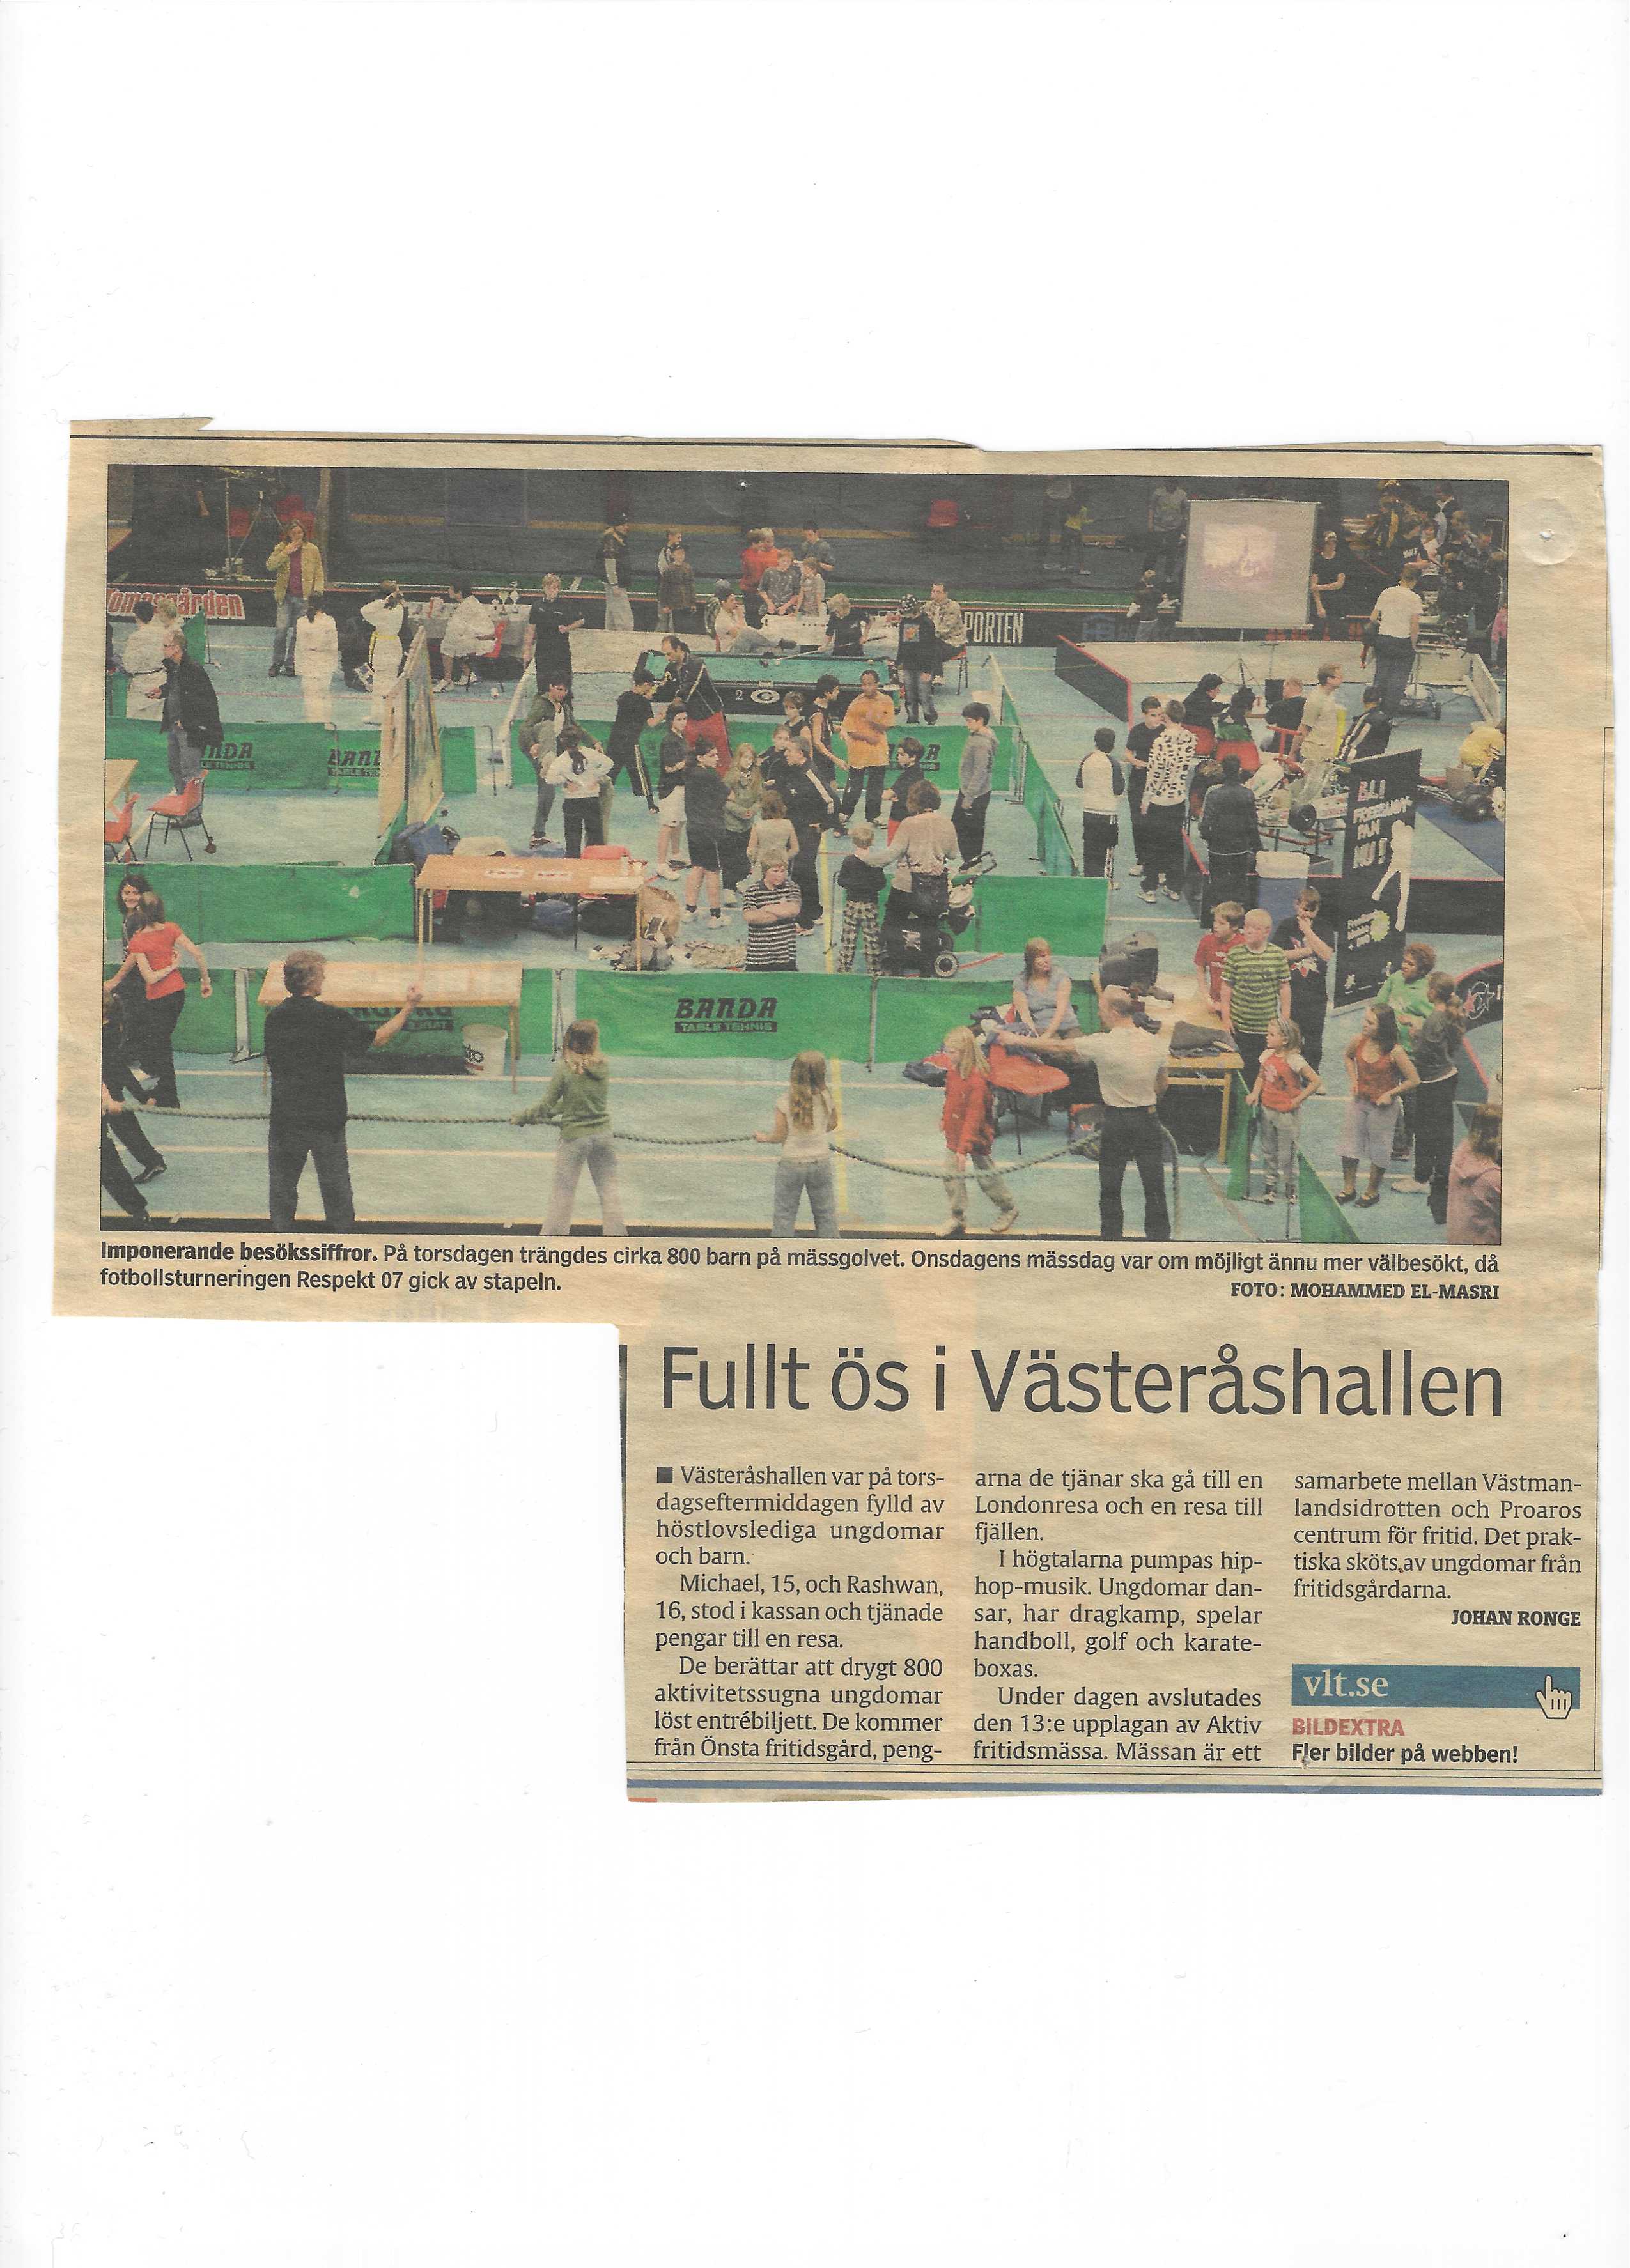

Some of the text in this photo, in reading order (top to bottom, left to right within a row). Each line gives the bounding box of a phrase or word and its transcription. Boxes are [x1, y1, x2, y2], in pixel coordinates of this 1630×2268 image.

[675, 997, 778, 1019] BANDA
[101, 1241, 1500, 1276] Imponerande besökssiffror. På torsdagen trängdes cirka 800 barn på mässgolvet. Onsdagens mässdag var om möjligt ännu mer välbesökt, då
[100, 1269, 561, 1294] fotbollsturneringen Respekt 07 gick av stapeln.
[1230, 1282, 1500, 1300] FOTO: MOHAMMED EL-MASRI
[663, 1343, 1502, 1417] Fullt ös i Västeråshallen
[680, 1465, 945, 1490] Västeråshallen var på tors-
[975, 1467, 1264, 1493] arna de tjänar ska gå till en
[1294, 1470, 1582, 1492] samarbete mellan Västman-
[656, 1492, 945, 1517] dagseftermiddagen fylld av
[975, 1495, 1263, 1516] Londonresa och en resa till
[1294, 1497, 1581, 1520] landsidrotten och Proaros
[656, 1518, 945, 1544] höstlovslediga ungdomar
[975, 1521, 1044, 1545] fjällen.
[1294, 1525, 1581, 1550] centrum för fritid. Det prak-
[656, 1545, 750, 1566] och barn.
[999, 1548, 1262, 1575] I högtalarna pumpas hip-
[1293, 1551, 1342, 1571] tiska
[1403, 1557, 1427, 1573] av
[1431, 1552, 1537, 1577] ungdomar
[1541, 1554, 1582, 1573] från
[679, 1573, 943, 1597] Michael, 15, och Rashwan,
[975, 1575, 1262, 1601] hop-musik. Ungdomar dan-
[1294, 1578, 1452, 1603] fritidsgårdarna.
[656, 1600, 943, 1626] 16, stod i kassan och tjänade
[974, 1603, 1263, 1629] sar, har dragkamp, spelar
[1450, 1610, 1581, 1627] JOHAN RONGE
[655, 1628, 844, 1652] pengar till en resa.
[974, 1630, 1262, 1655] handboll, golf och karate-
[679, 1655, 943, 1681] De berättar att drygt 800
[974, 1658, 1038, 1678] boxas.
[655, 1683, 943, 1708] aktivitetssugna ungdomar
[1303, 1669, 1389, 1698] vlt.se
[998, 1686, 1261, 1710] Under dagen avslutades
[655, 1709, 943, 1734] löst entrébiljett. De kommer
[973, 1713, 1262, 1738] den 13:e upplagan av Aktiv
[1292, 1717, 1406, 1737] BILDEXTRA
[654, 1734, 942, 1763] från Önsta fritidsgård, peng-
[973, 1740, 1262, 1761] fritidsmässa. Mässan är ett
[1292, 1743, 1519, 1766] Fler bilder på webben!
